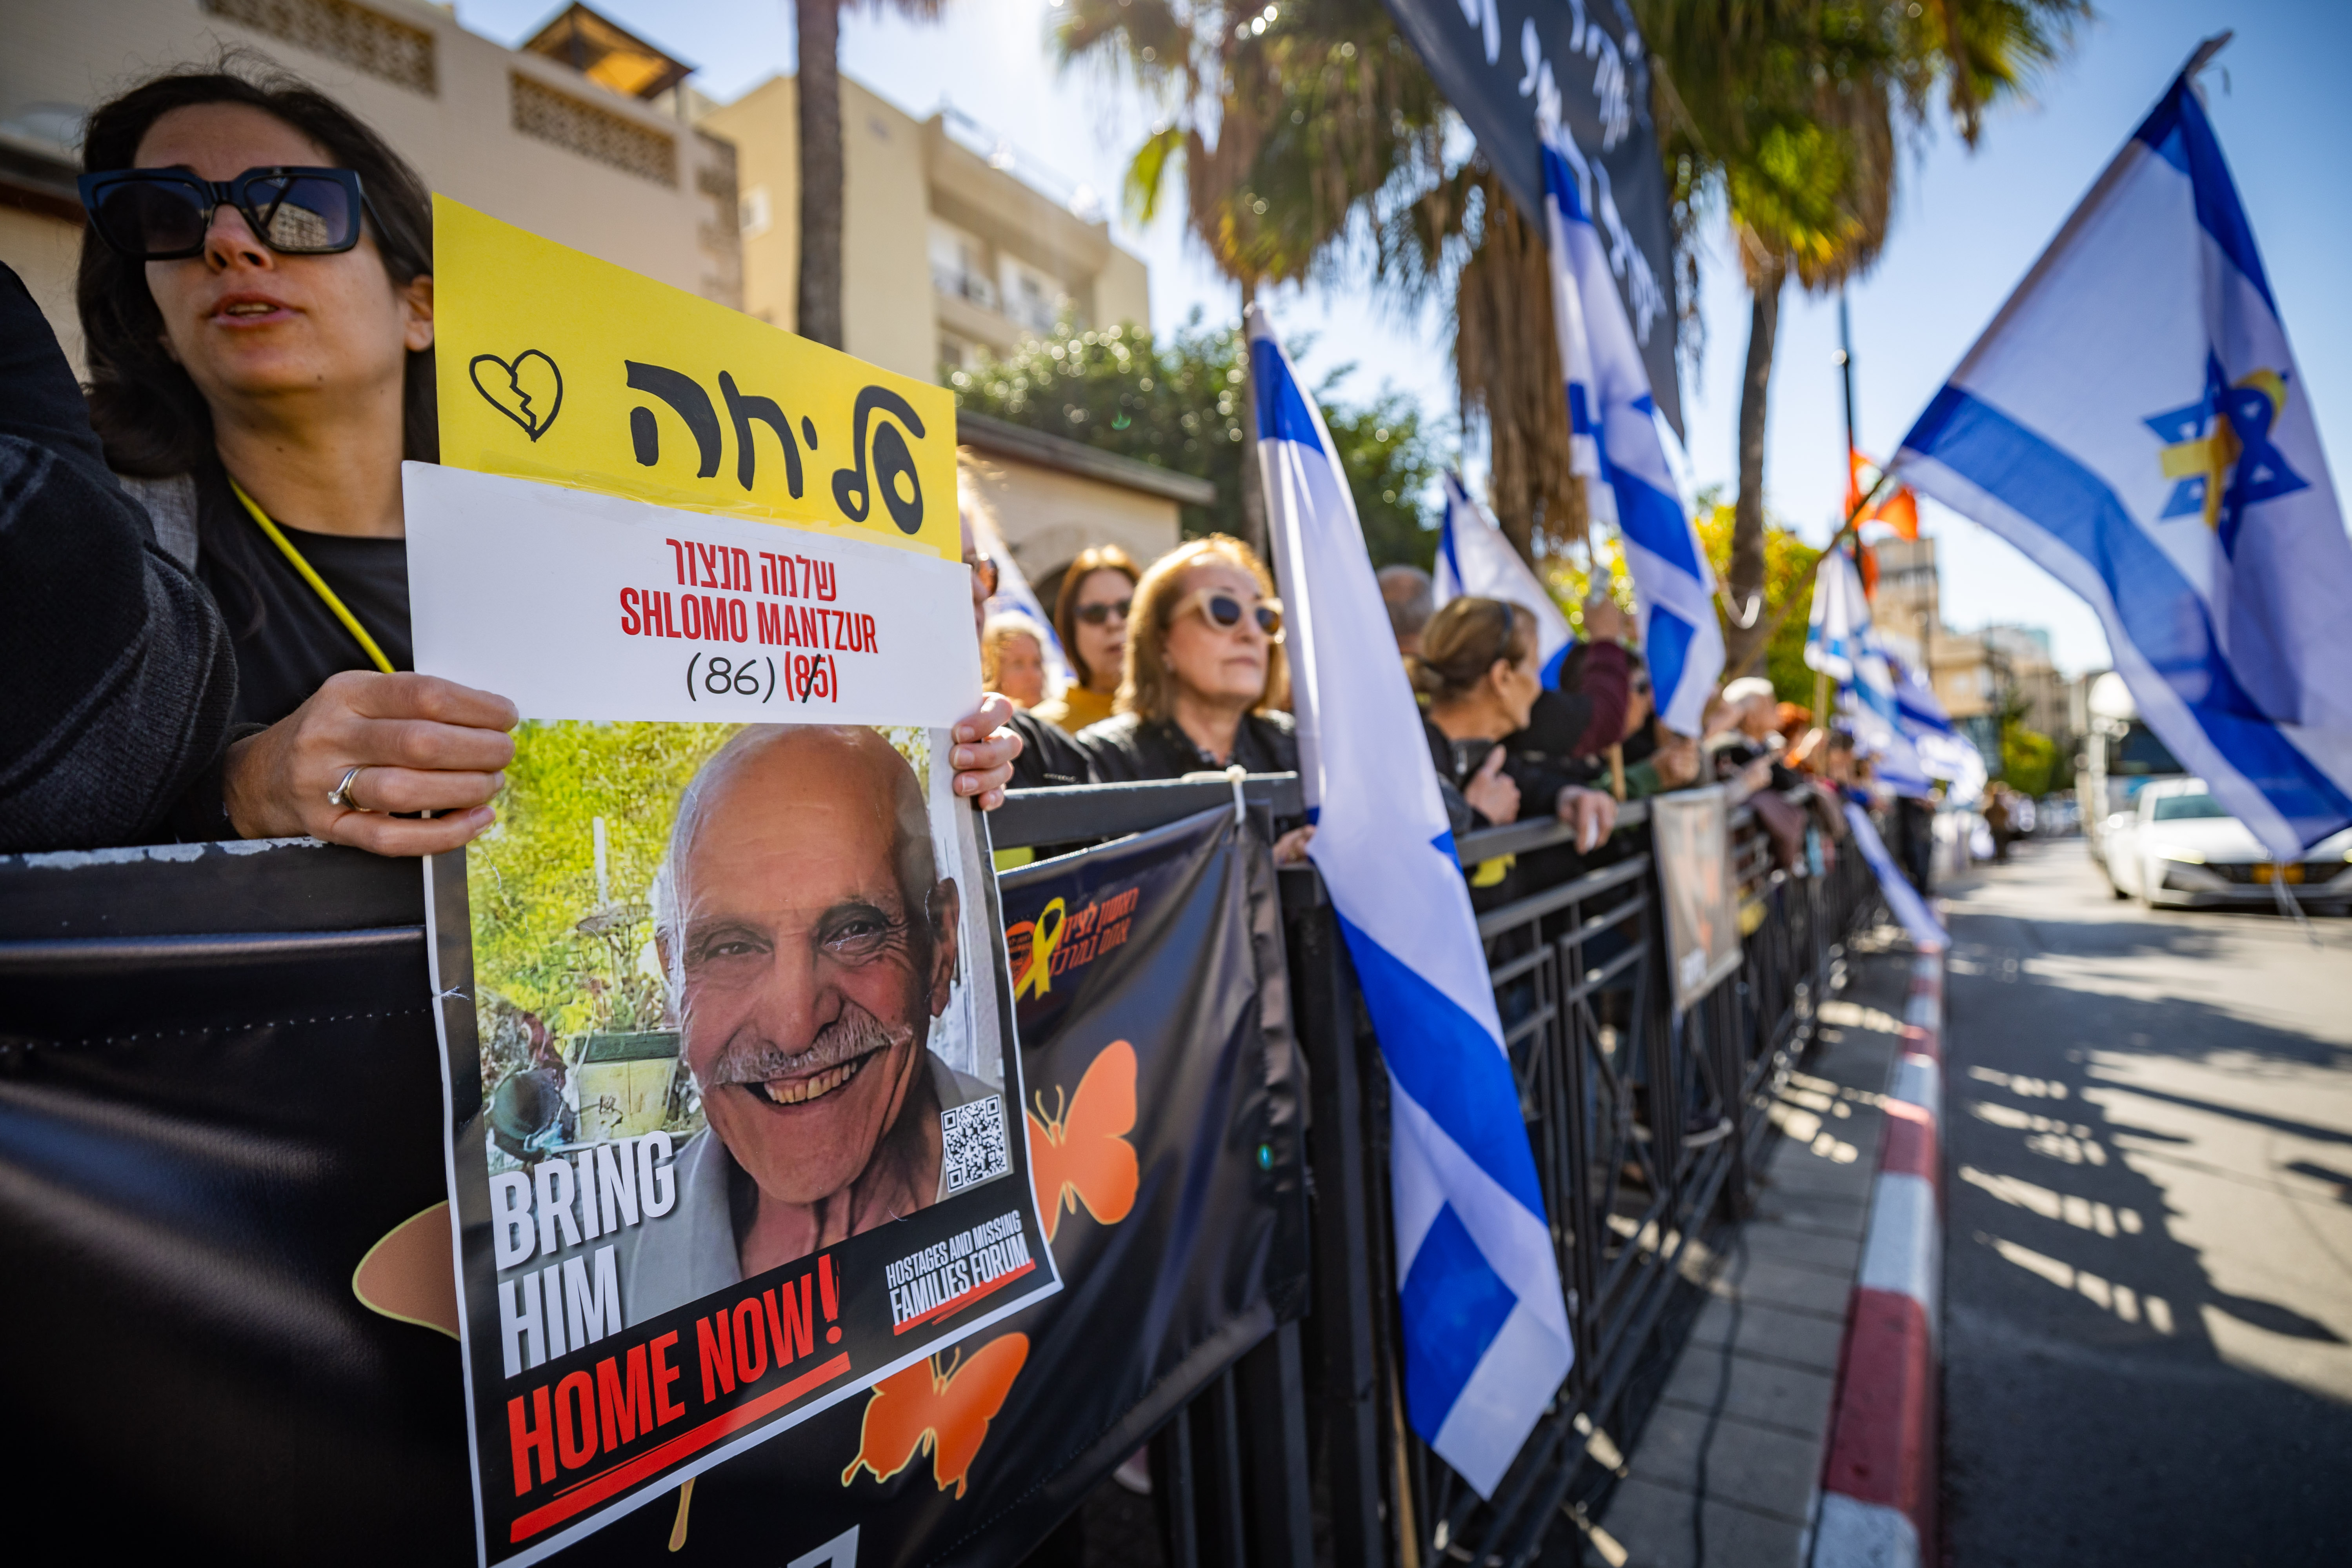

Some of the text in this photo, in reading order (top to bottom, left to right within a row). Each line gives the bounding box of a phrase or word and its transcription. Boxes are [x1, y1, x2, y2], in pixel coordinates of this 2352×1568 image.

[624, 360, 925, 535] סליחה
[666, 538, 837, 602] שלמה מנצור
[620, 587, 878, 654] SHLOMO MANTZUR
[687, 652, 775, 704] (86)
[489, 1130, 675, 1271] BRING
[885, 1209, 1022, 1290] HOSTAGES AND MISSING
[889, 1232, 1031, 1326] FAMILIES FORUM
[498, 1244, 622, 1379] HIM
[507, 1253, 842, 1497] HOME NOW!
